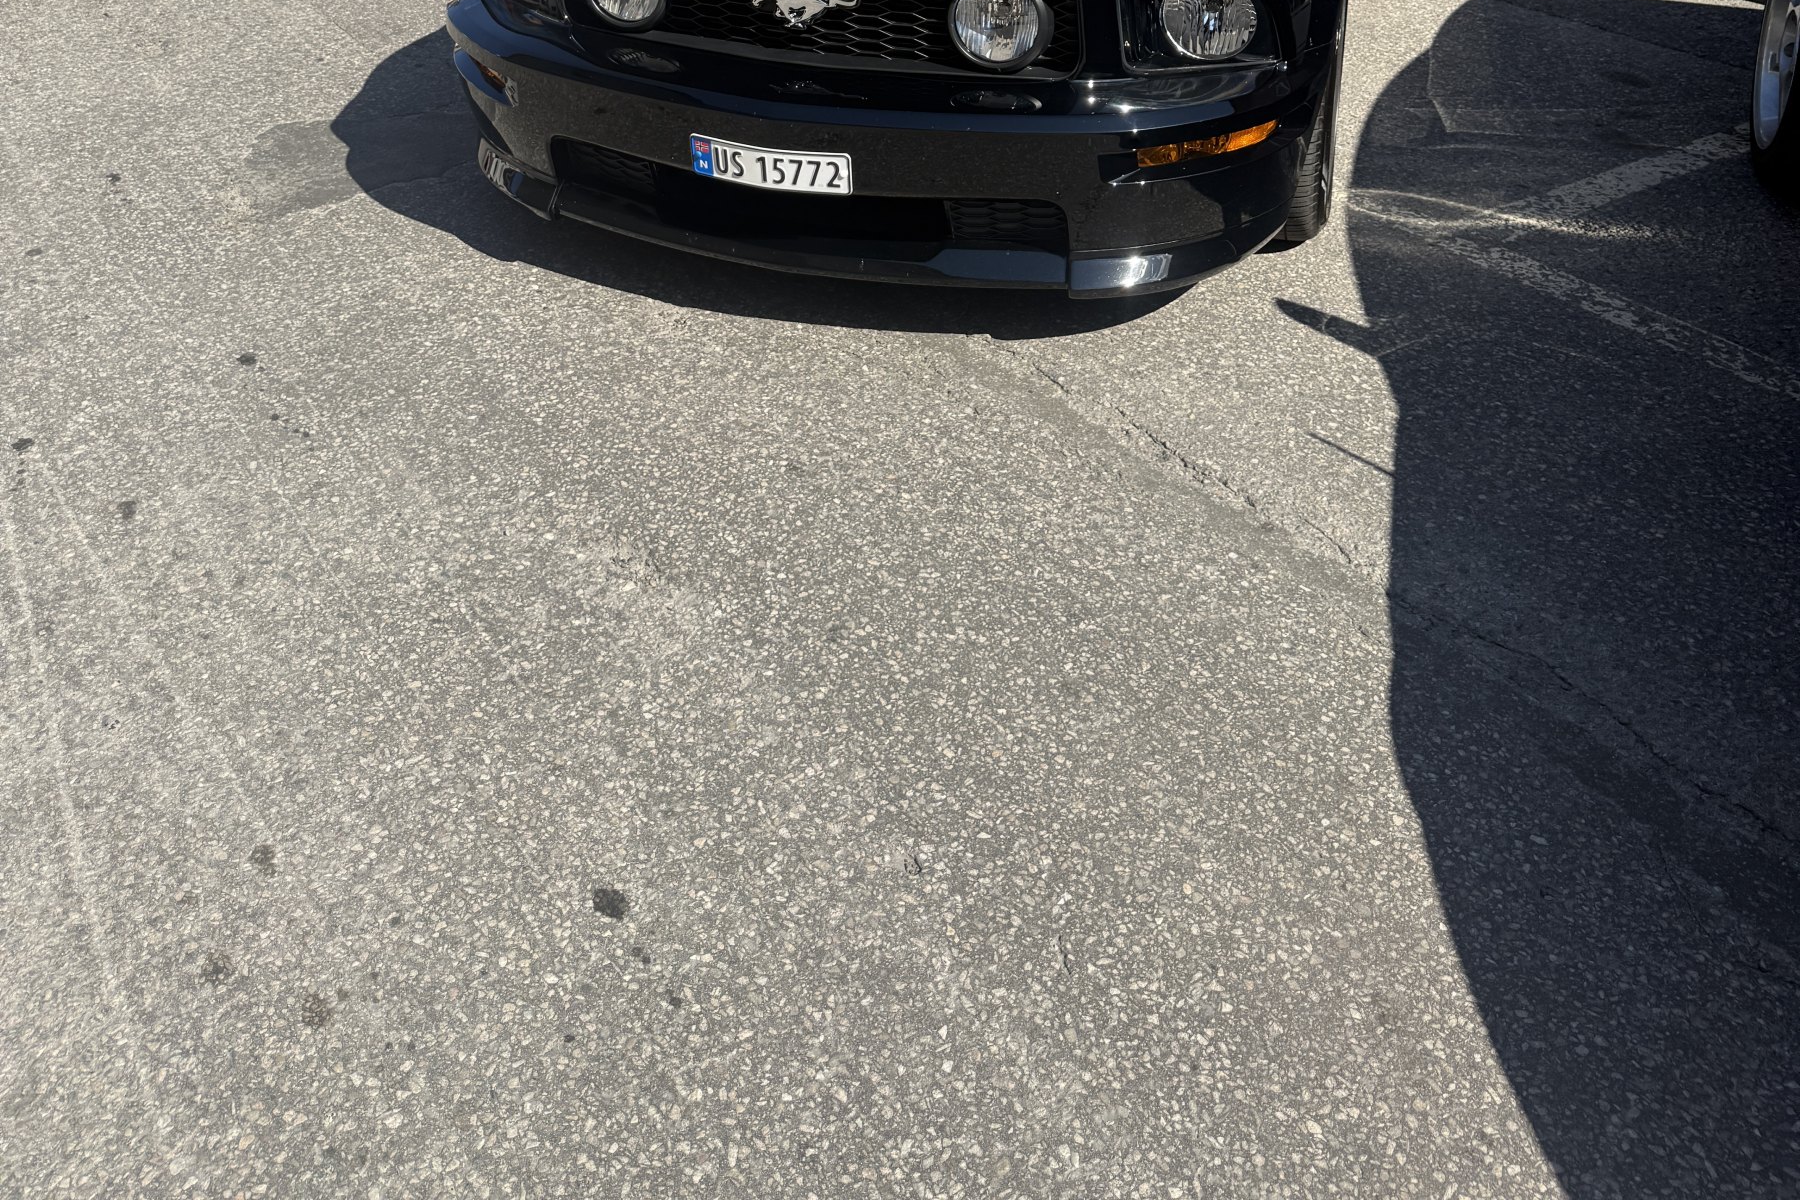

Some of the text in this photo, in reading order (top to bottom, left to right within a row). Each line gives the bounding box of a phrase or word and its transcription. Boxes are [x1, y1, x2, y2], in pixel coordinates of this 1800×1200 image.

[700, 160, 709, 169] N
[713, 145, 842, 189] US 15772
